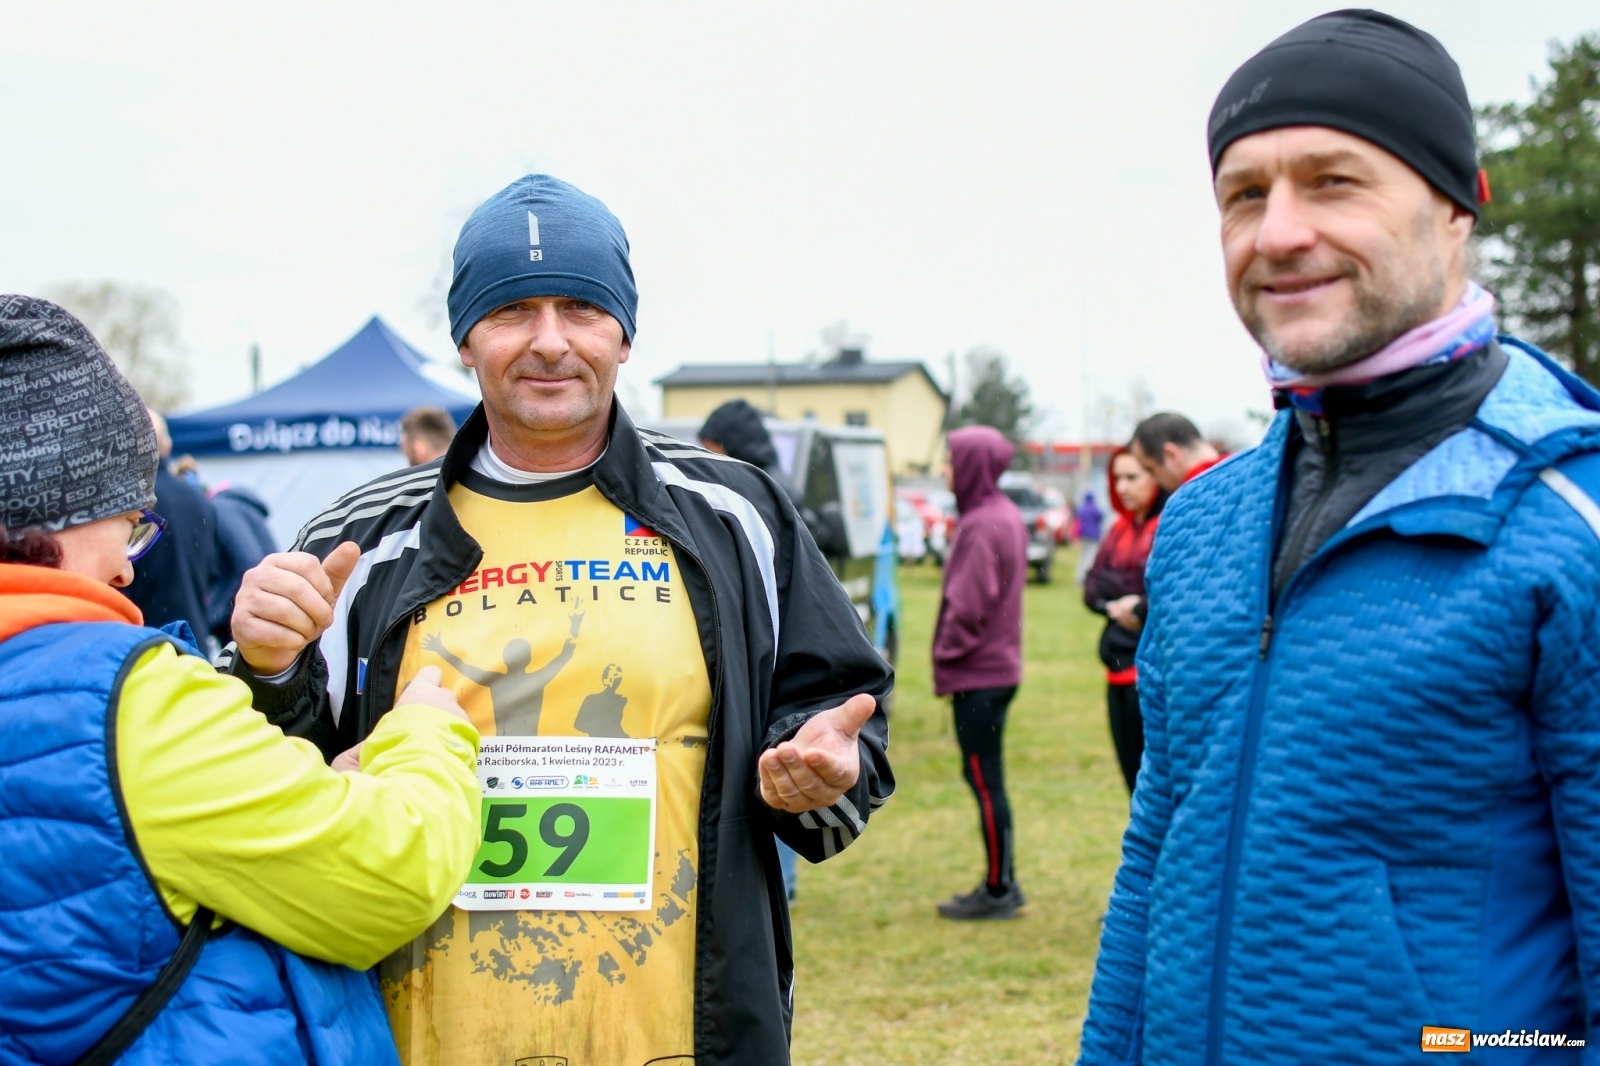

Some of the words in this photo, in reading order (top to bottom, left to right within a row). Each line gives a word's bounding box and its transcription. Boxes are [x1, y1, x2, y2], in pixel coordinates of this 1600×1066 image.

[51, 359, 102, 384] Welding
[71, 375, 91, 387] work
[14, 376, 52, 394] HI-VIS
[24, 383, 73, 404] GLOVES
[55, 388, 90, 406] BOOTS
[31, 409, 57, 423] ESD
[100, 403, 118, 415] ESD
[25, 405, 100, 436] STRETCH
[88, 410, 125, 431] HI-VIS
[31, 432, 56, 443] work
[228, 417, 318, 452] Dołącz
[319, 413, 357, 446] do
[0, 442, 61, 464] Welding
[67, 448, 105, 469] work
[37, 465, 64, 479] ESD
[70, 452, 128, 480] Welding
[11, 474, 70, 497] stretch
[65, 485, 97, 503] ESD
[100, 487, 126, 500] HI-VIS
[93, 490, 137, 513] SAFETY
[0, 501, 60, 528] EAR
[624, 538, 669, 548] CZECH
[624, 547, 669, 557] REPUBLIC
[446, 560, 553, 596] ERGY
[555, 560, 563, 582] SPORTS
[564, 560, 670, 583] TEAM
[413, 585, 671, 626] BOLATICE
[479, 744, 505, 754] ański
[506, 744, 562, 754] Półmaraton
[565, 744, 593, 755] Leśny
[595, 745, 644, 755] RAFAMET
[484, 757, 540, 767] Raciborska,
[542, 757, 547, 766] 1
[550, 757, 590, 766] kwietnia
[592, 758, 617, 767] 2023
[478, 802, 590, 878] 59
[484, 889, 515, 899] nowiny.pl
